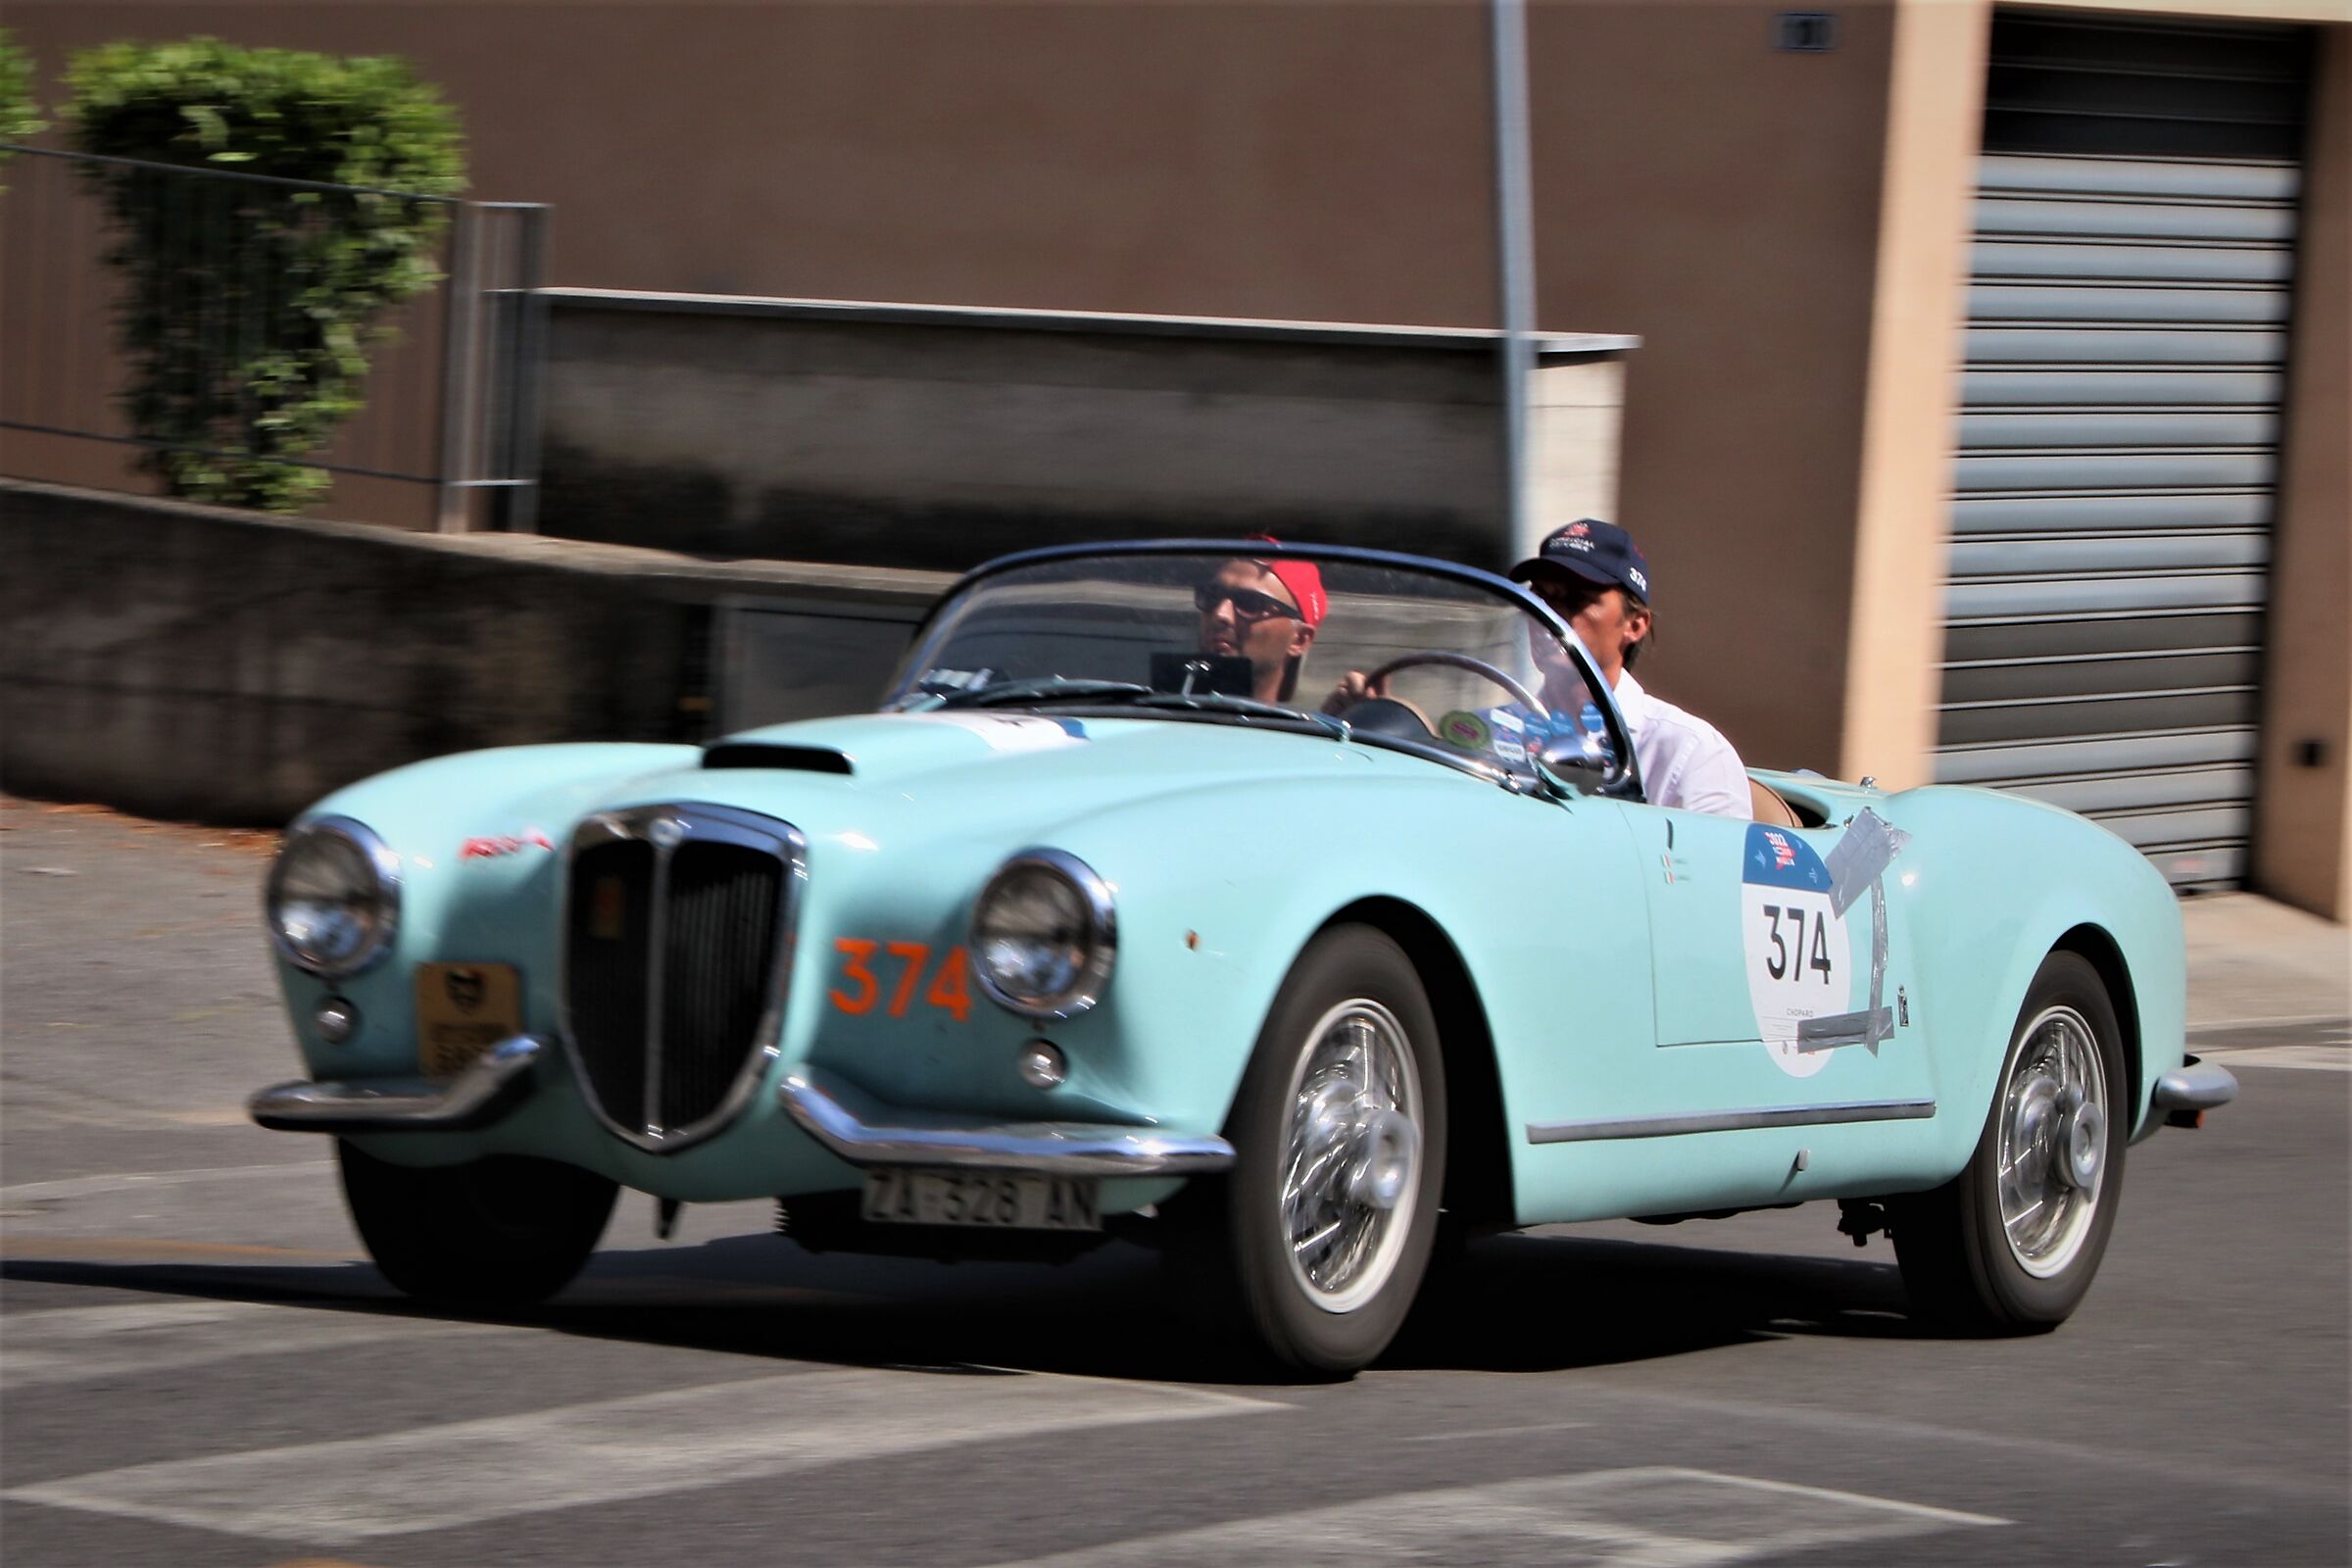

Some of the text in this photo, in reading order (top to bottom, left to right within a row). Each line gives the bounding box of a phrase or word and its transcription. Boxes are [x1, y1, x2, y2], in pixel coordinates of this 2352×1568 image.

[829, 937, 972, 1023] 374
[1763, 905, 1832, 985] 374
[867, 1173, 917, 1218] ZA
[1047, 1179, 1099, 1226] AN
